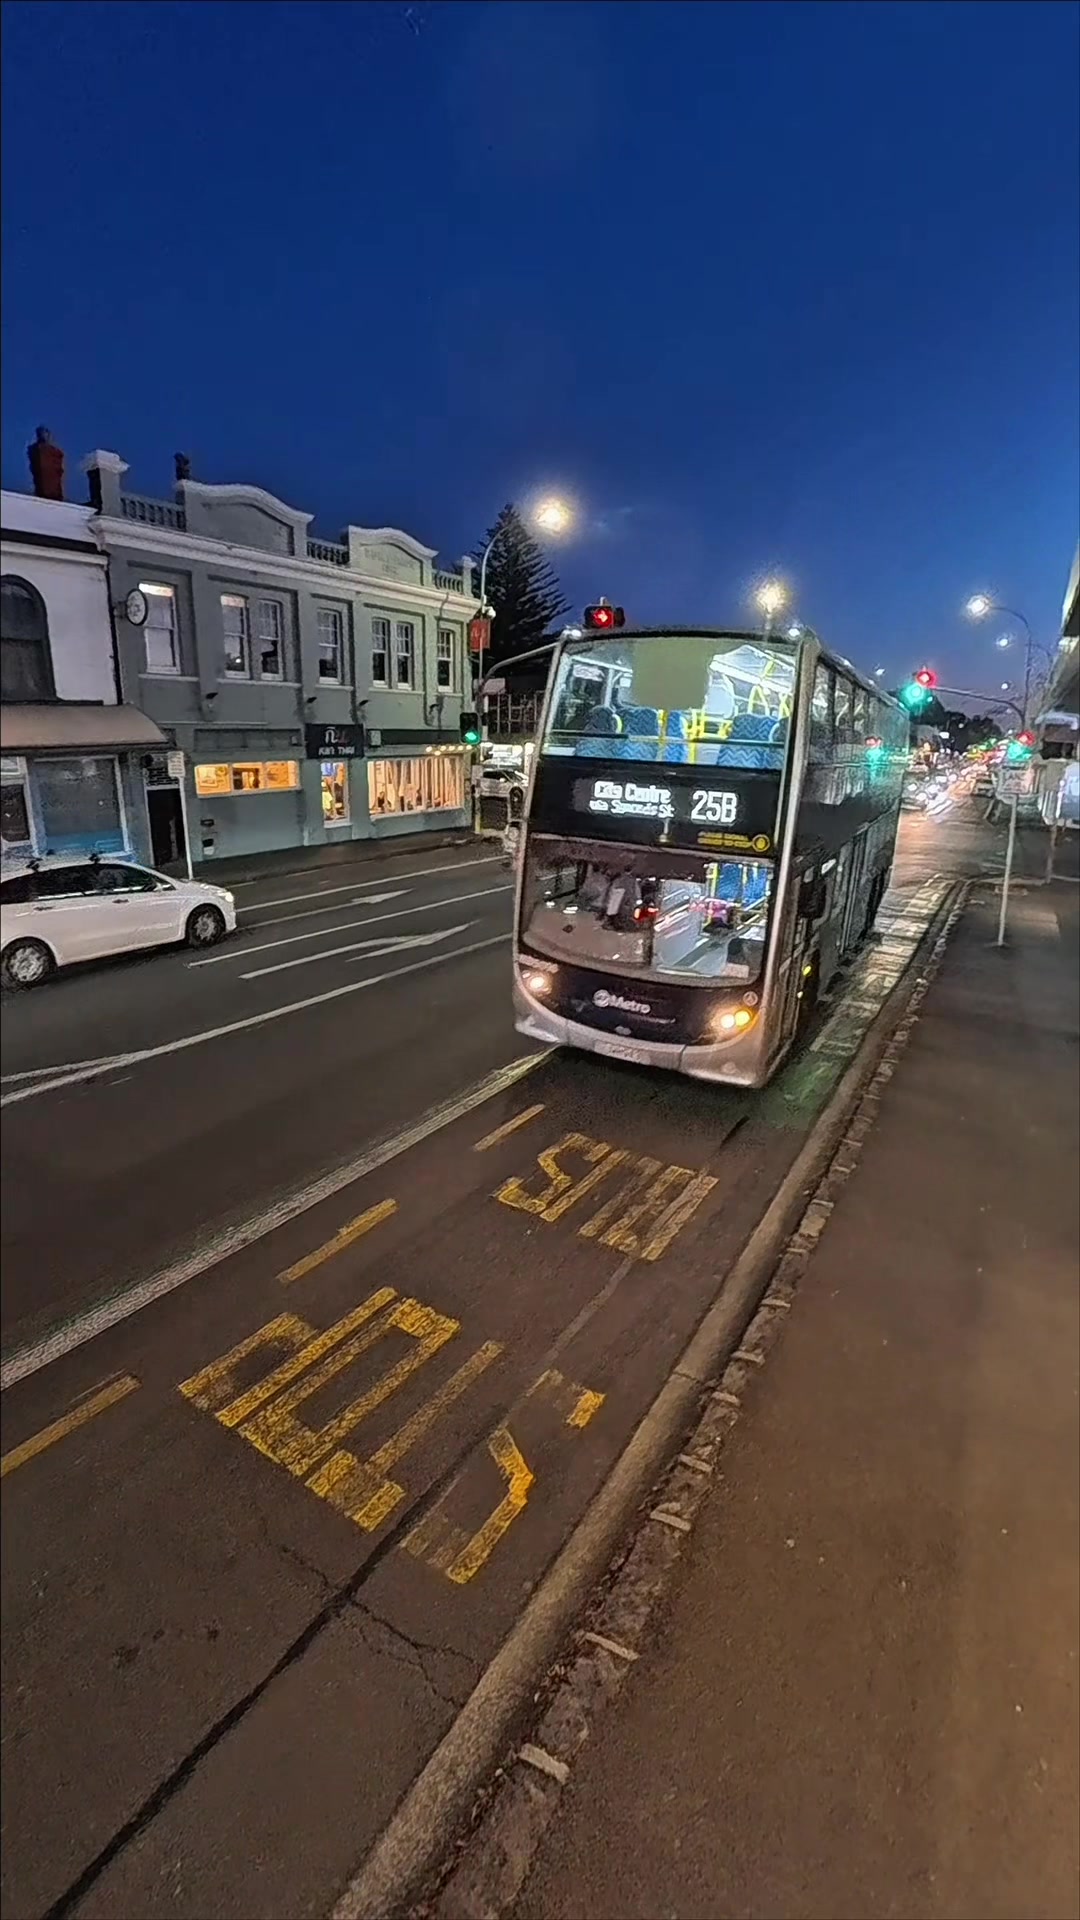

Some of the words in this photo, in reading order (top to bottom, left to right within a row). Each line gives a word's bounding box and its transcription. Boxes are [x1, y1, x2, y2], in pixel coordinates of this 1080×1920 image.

[625, 782, 671, 804] Centre
[658, 803, 675, 818] St
[691, 790, 737, 823] 25B
[609, 994, 651, 1014] Metro
